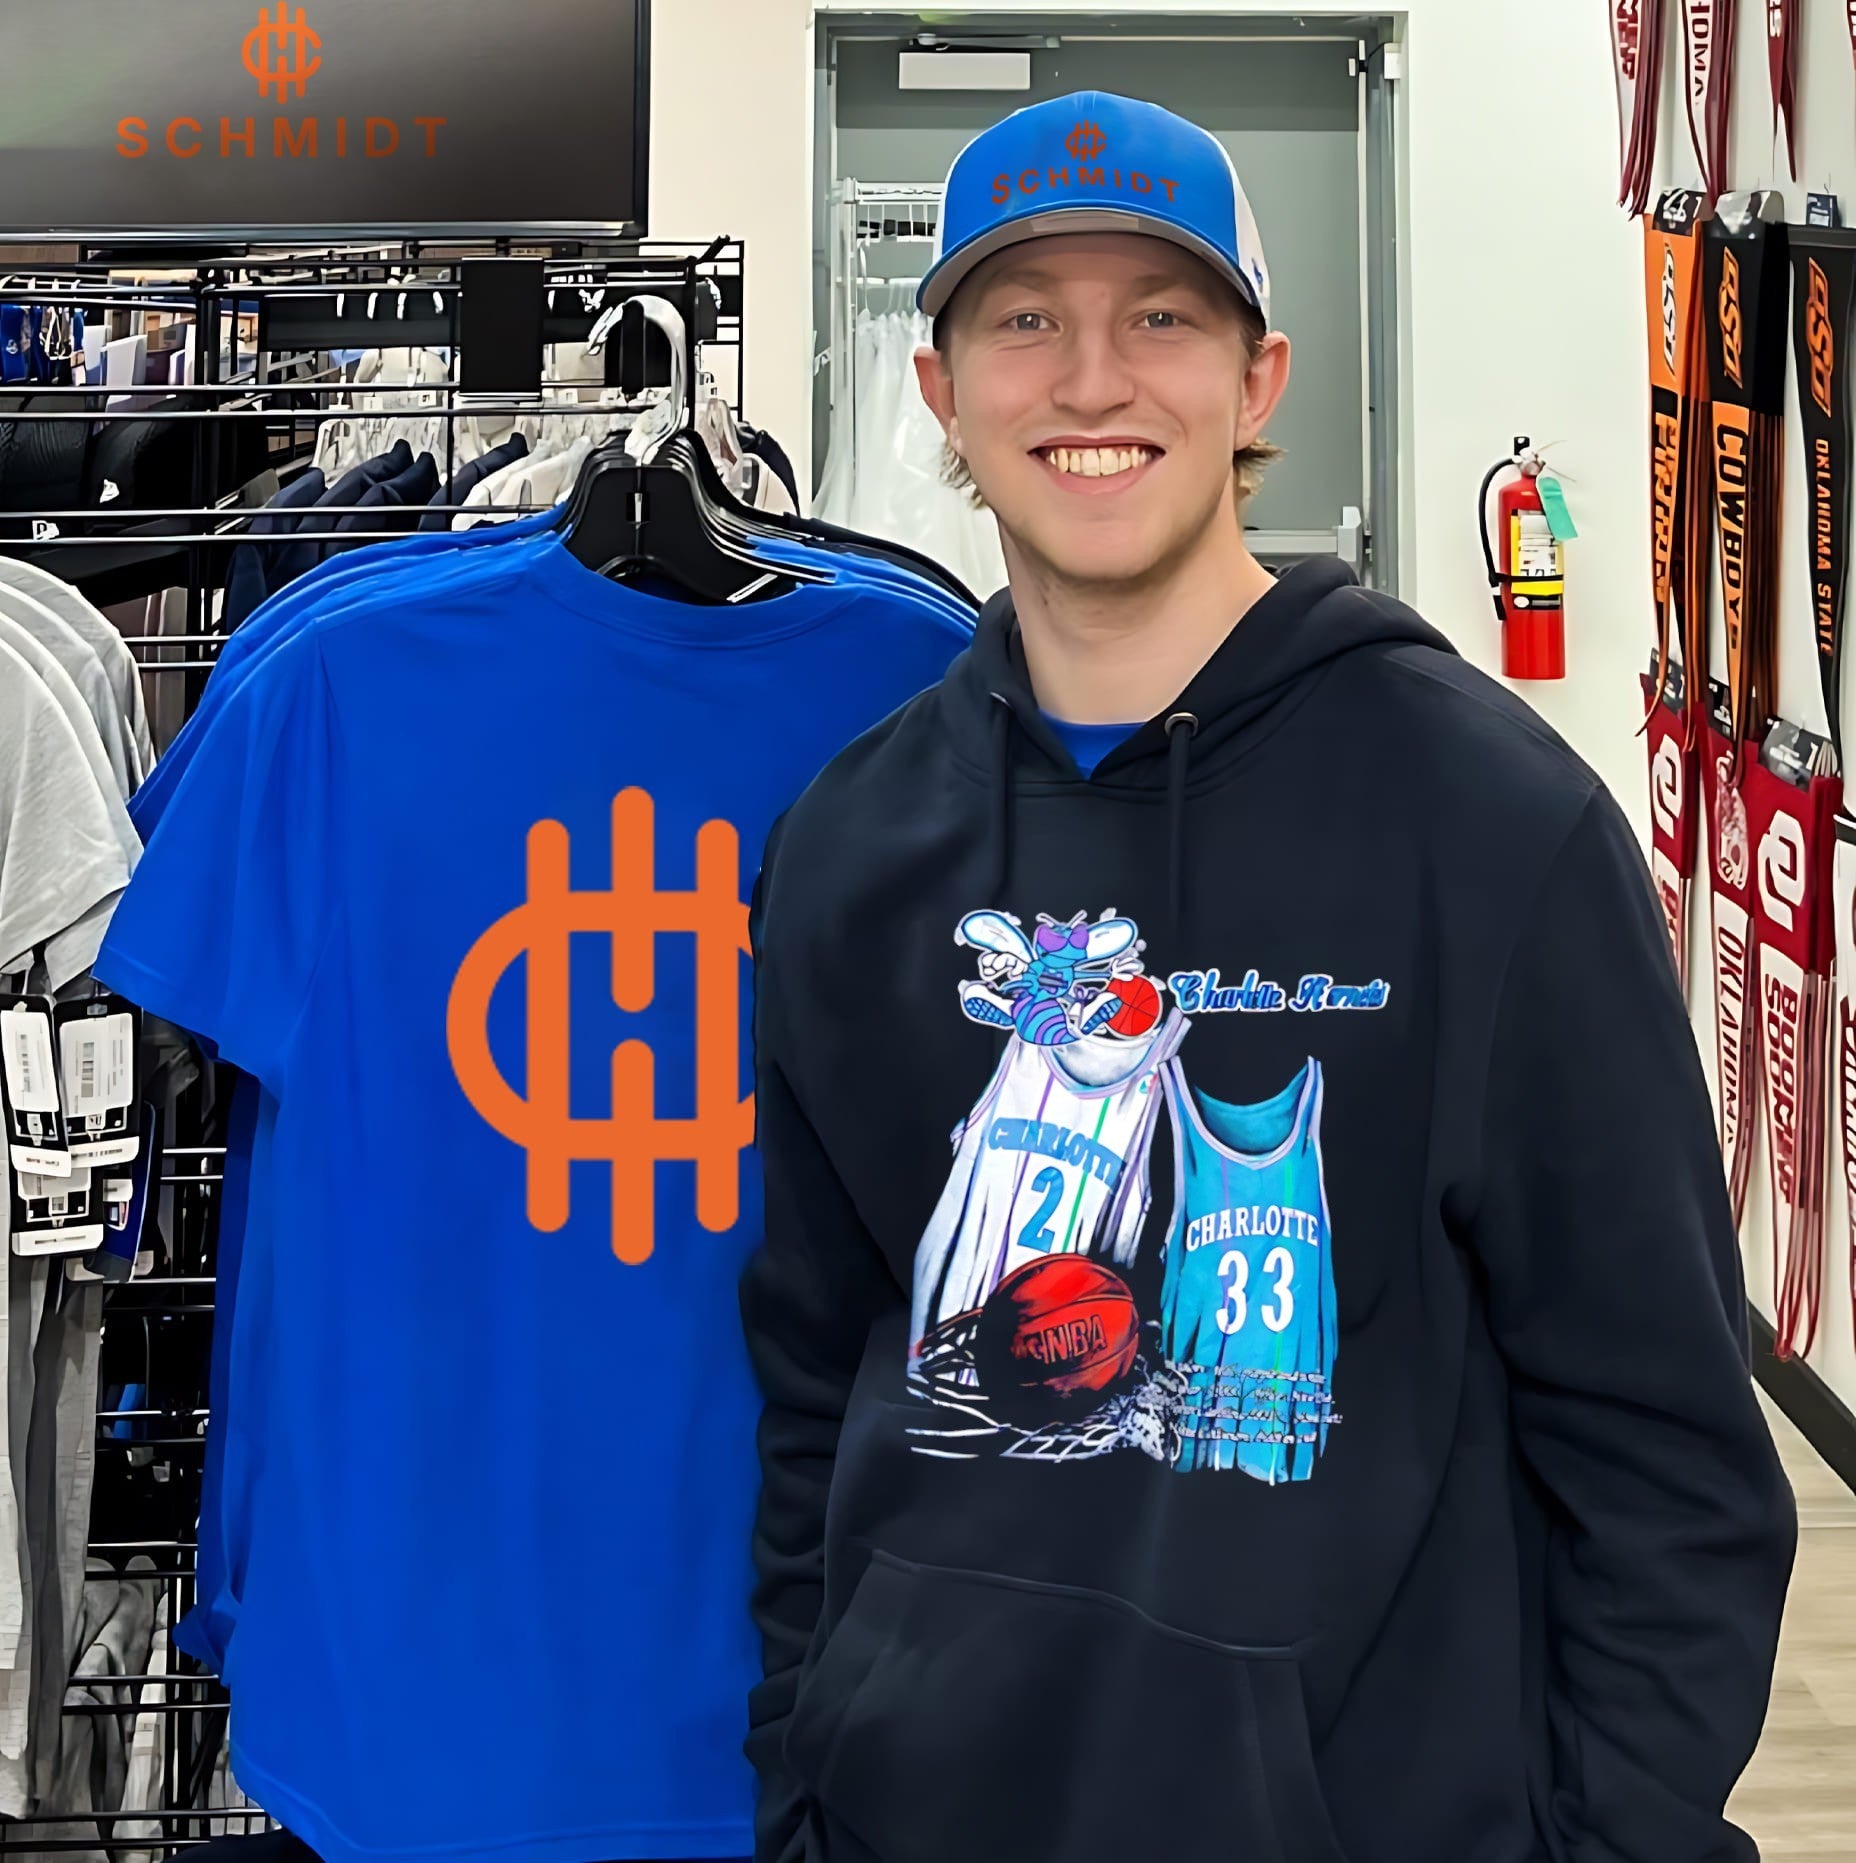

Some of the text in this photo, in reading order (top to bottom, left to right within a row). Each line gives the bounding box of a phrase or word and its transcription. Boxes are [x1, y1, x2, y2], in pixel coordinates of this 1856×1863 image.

[115, 116, 447, 159] SCHMIDT
[992, 167, 1179, 204] SCHMIDT
[1815, 439, 1832, 570] OKLAHOMA
[1718, 926, 1744, 1144] OKLAHOMA
[1017, 1166, 1064, 1254] 2
[1186, 1205, 1319, 1252] CHARLOTTE
[1216, 1247, 1294, 1335] 33
